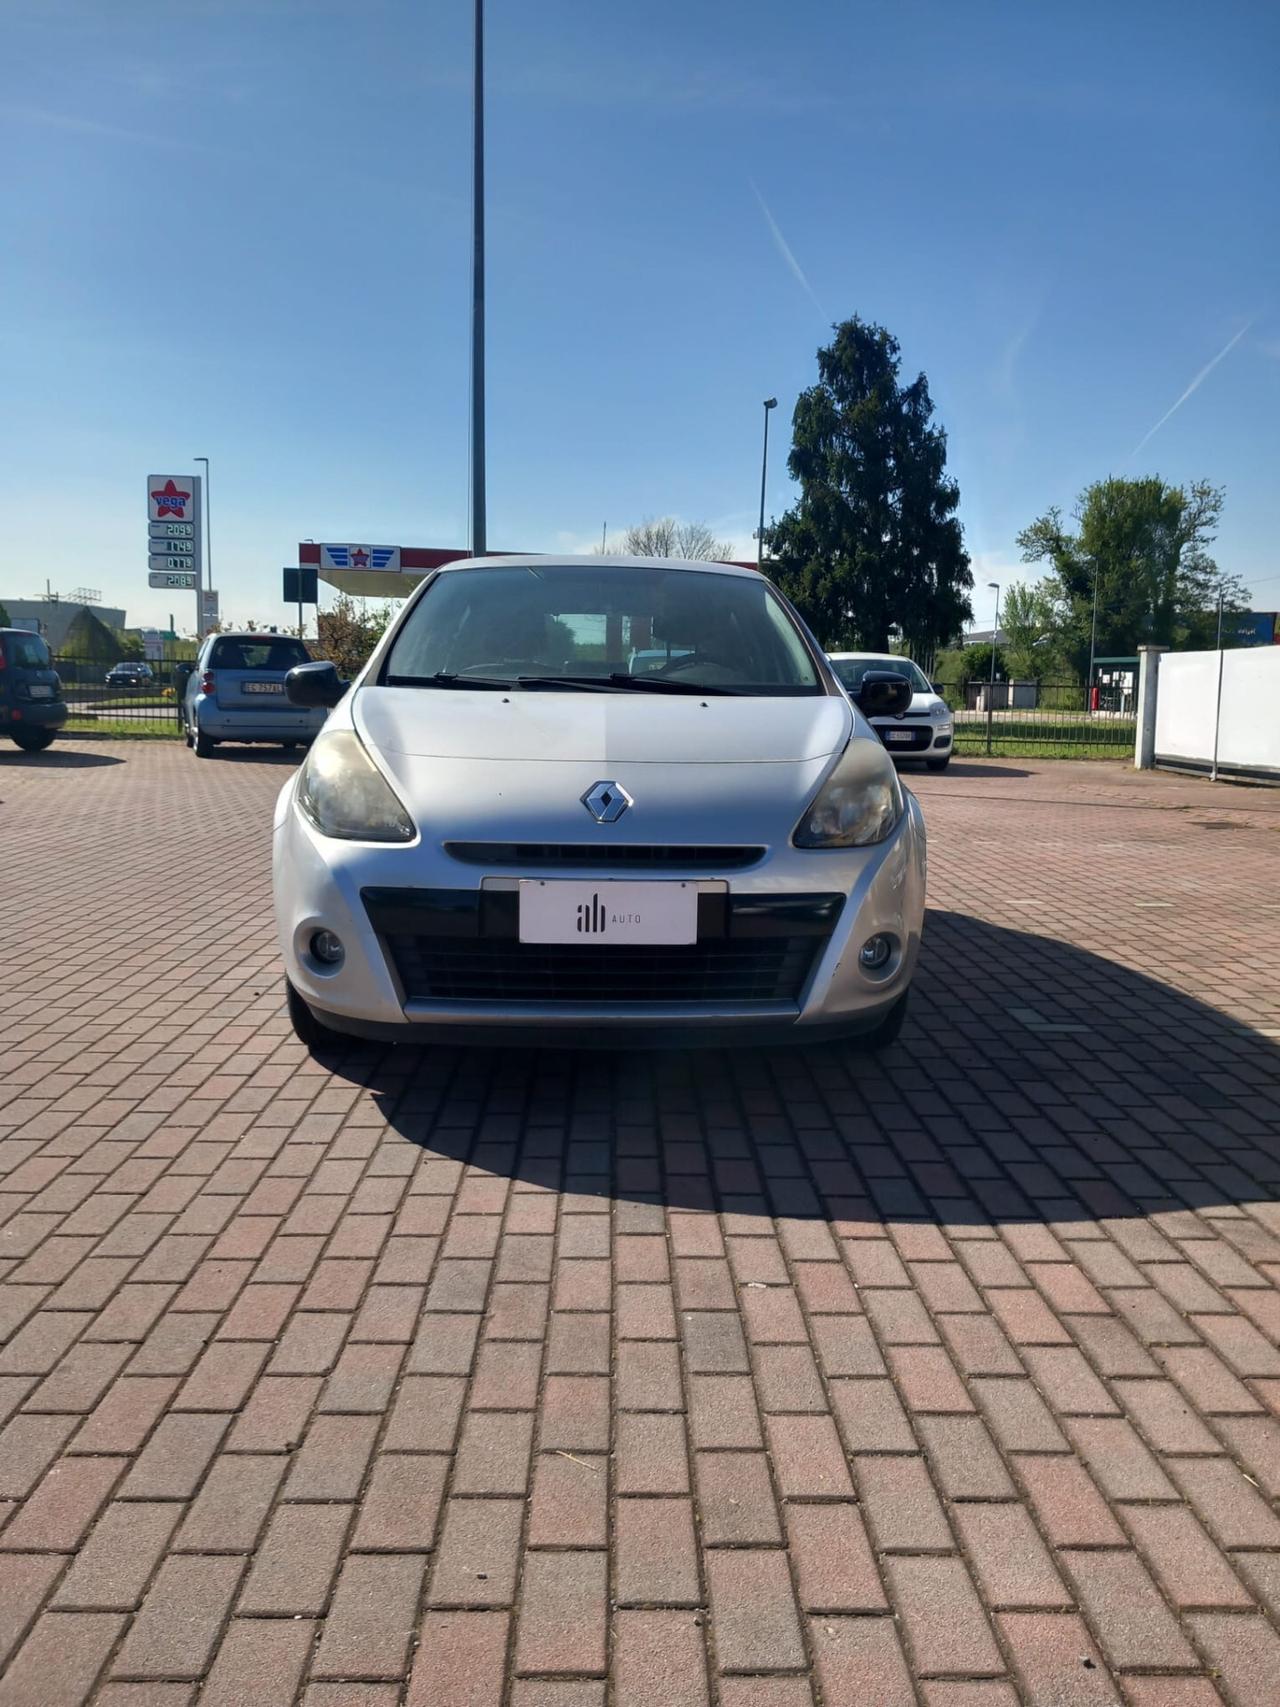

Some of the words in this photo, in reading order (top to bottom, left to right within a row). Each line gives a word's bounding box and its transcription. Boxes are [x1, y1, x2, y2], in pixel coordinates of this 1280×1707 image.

[156, 496, 186, 508] vega
[167, 524, 192, 536] 2099
[612, 914, 641, 923] AUTO
